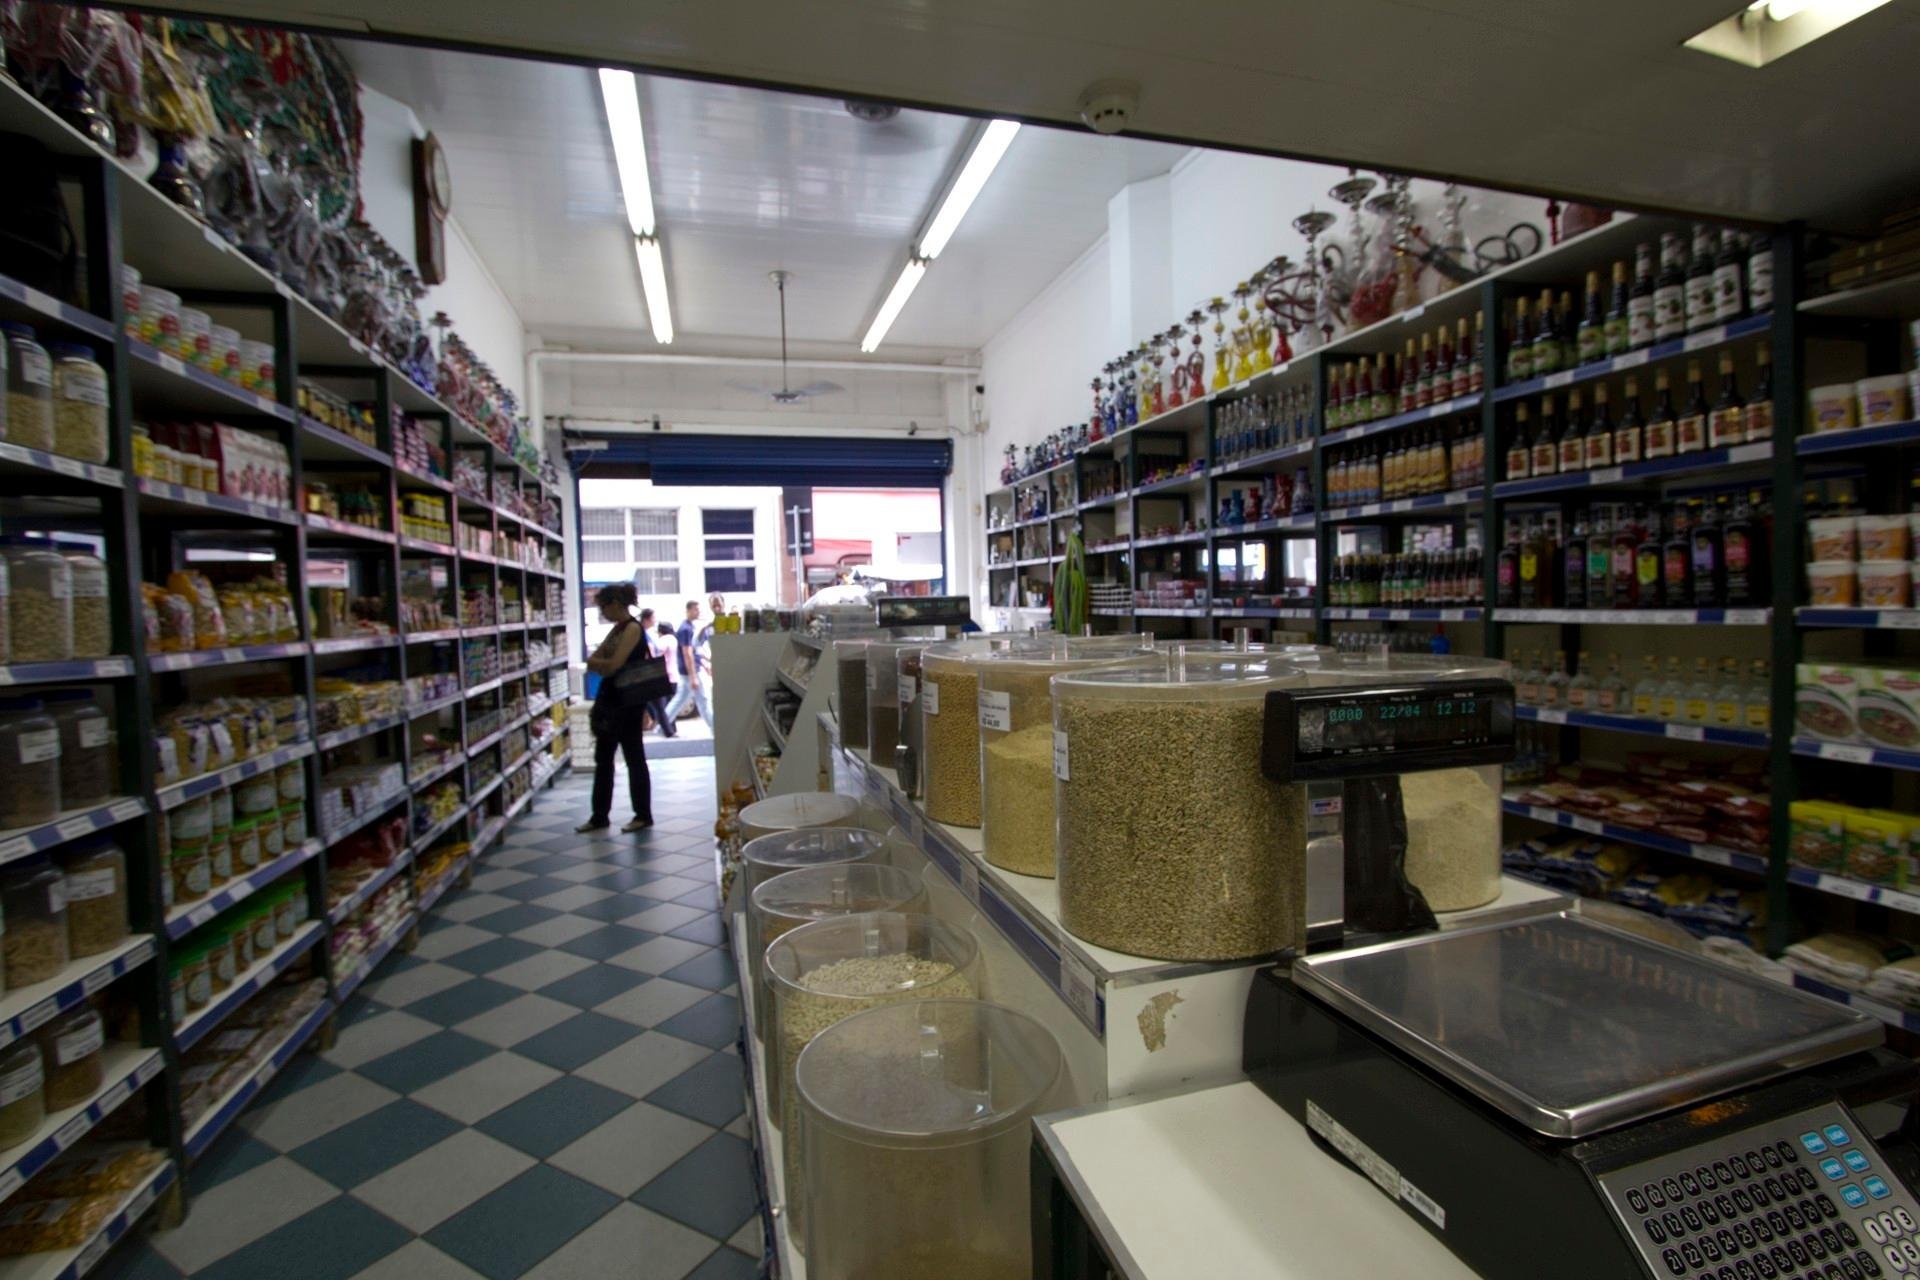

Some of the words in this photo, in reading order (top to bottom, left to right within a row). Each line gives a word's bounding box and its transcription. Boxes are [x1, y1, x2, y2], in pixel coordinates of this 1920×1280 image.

[1437, 701, 1453, 716] 12
[1461, 701, 1476, 714] 12
[1870, 1224, 1881, 1237] 1
[1885, 1218, 1897, 1231] 2
[1900, 1212, 1912, 1225] 3
[1890, 1251, 1902, 1264] 4
[1904, 1245, 1917, 1259] 5
